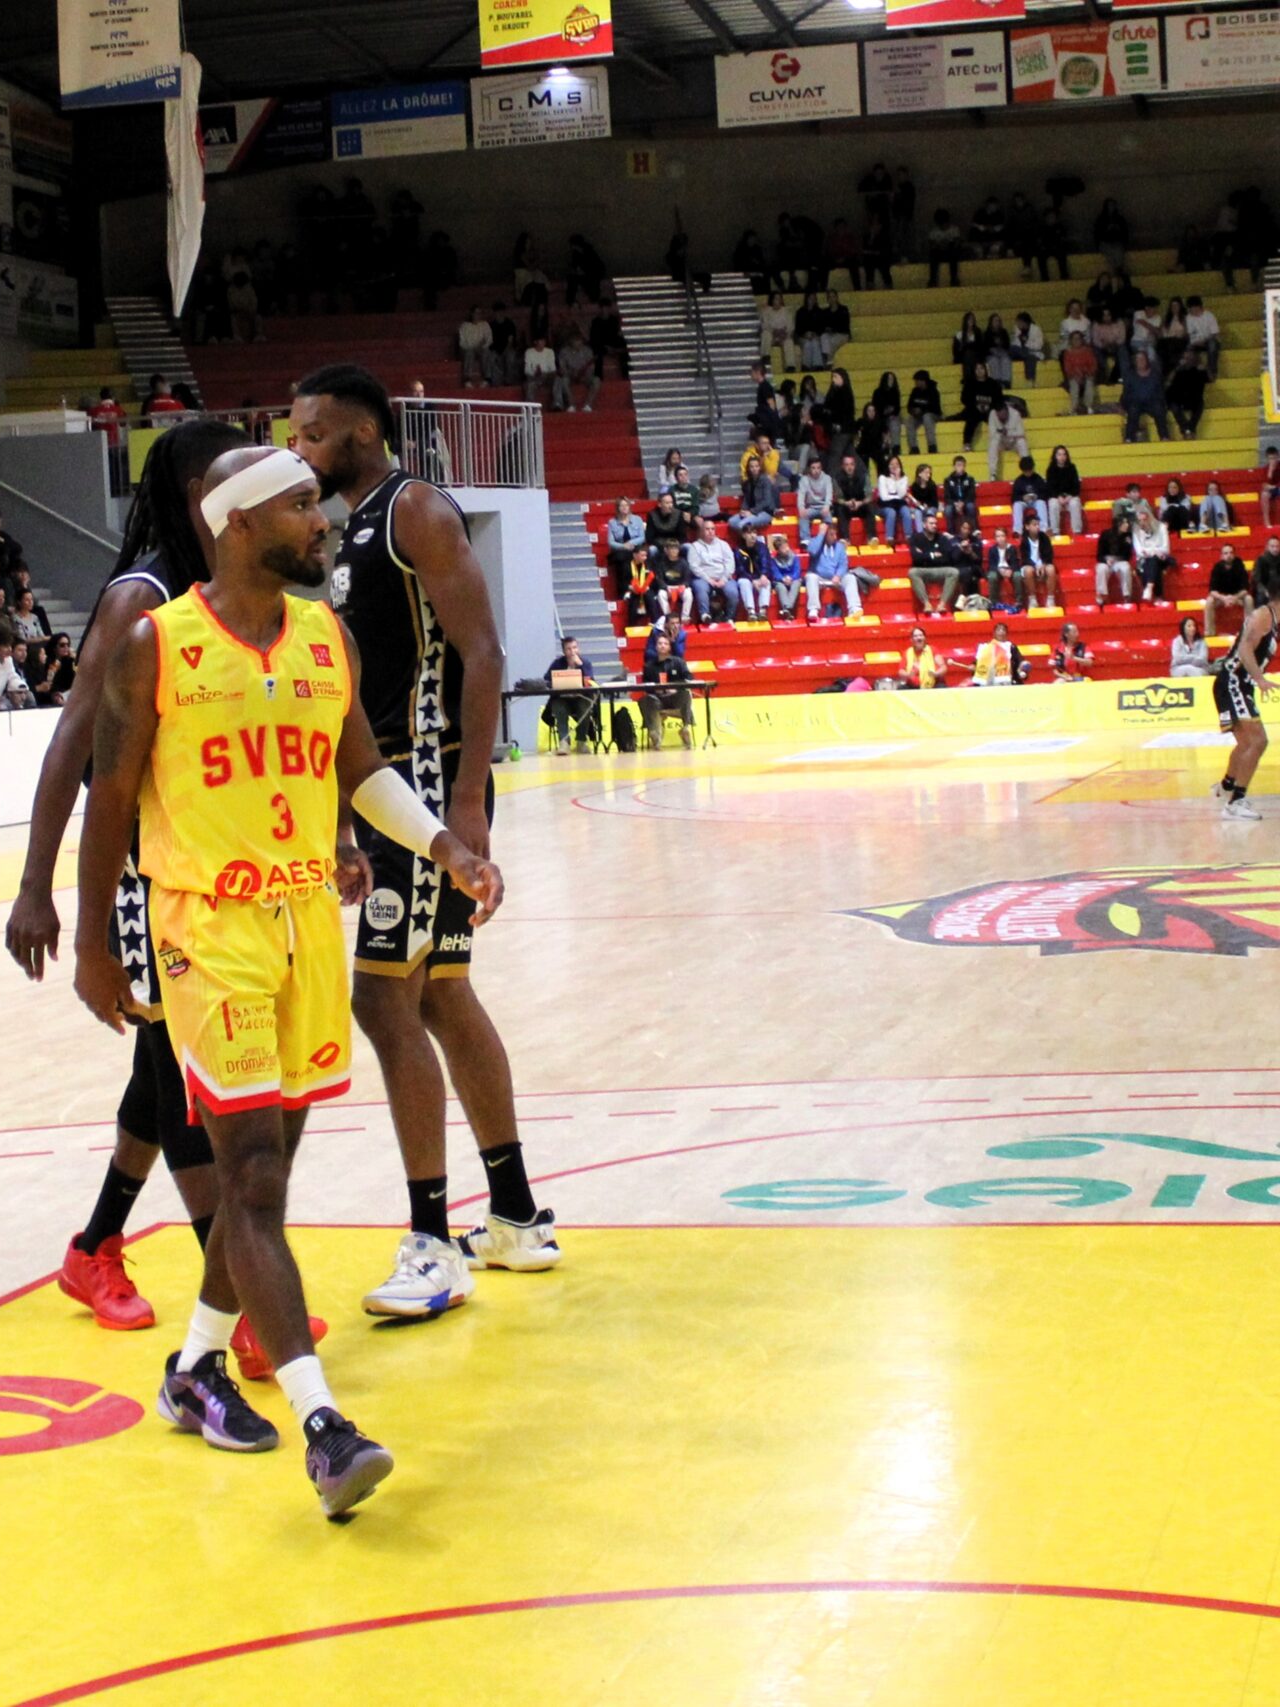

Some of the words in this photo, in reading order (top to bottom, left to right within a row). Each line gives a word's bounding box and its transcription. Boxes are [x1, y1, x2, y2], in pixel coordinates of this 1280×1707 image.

[946, 63, 980, 77] ATEC
[749, 85, 826, 103] CUYNAT
[339, 99, 378, 115] ALLEZ
[381, 97, 399, 112] LA
[403, 91, 453, 109] DRÔME!
[748, 100, 828, 113] CONSTRUCTION
[203, 127, 231, 144] AXA
[632, 152, 651, 174] H
[176, 686, 223, 707] Lapize
[1122, 688, 1190, 707] REVOL
[270, 792, 295, 841] 3
[369, 904, 399, 913] HAVRE
[371, 911, 398, 920] SEINE
[235, 1018, 274, 1031] VALLIE
